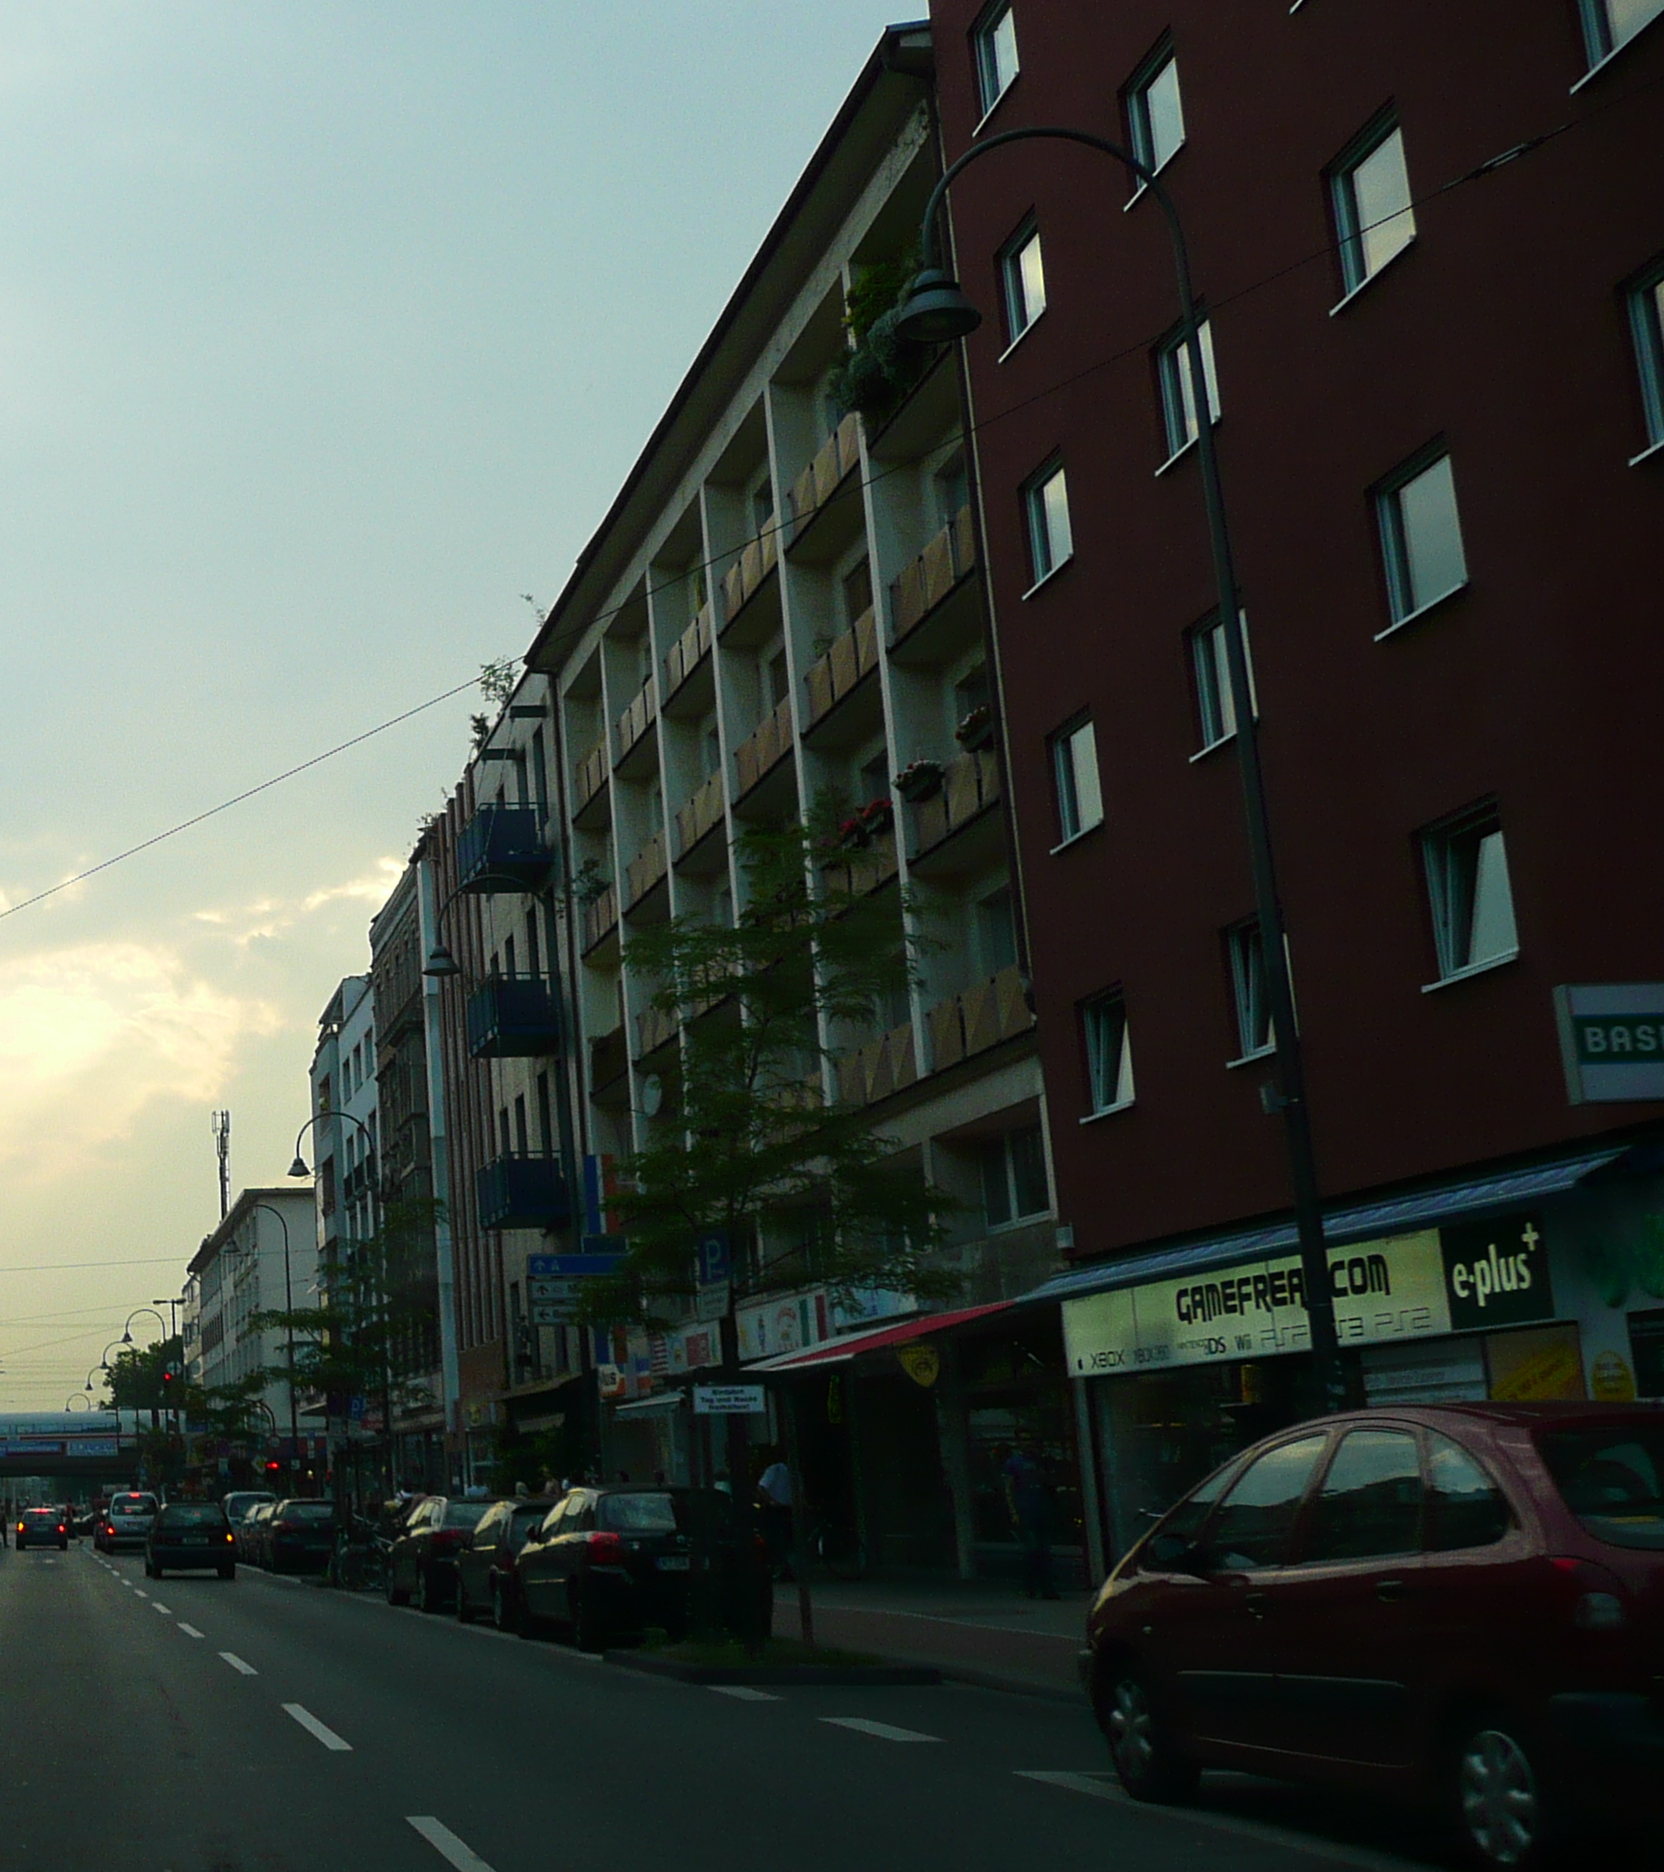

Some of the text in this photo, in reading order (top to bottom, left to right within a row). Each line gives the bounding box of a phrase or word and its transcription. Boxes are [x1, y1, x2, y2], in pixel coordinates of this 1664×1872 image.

[1090, 1351, 1126, 1370] XBOX
[1234, 1334, 1252, 1350] Wii
[1373, 1307, 1433, 1333] PS2
